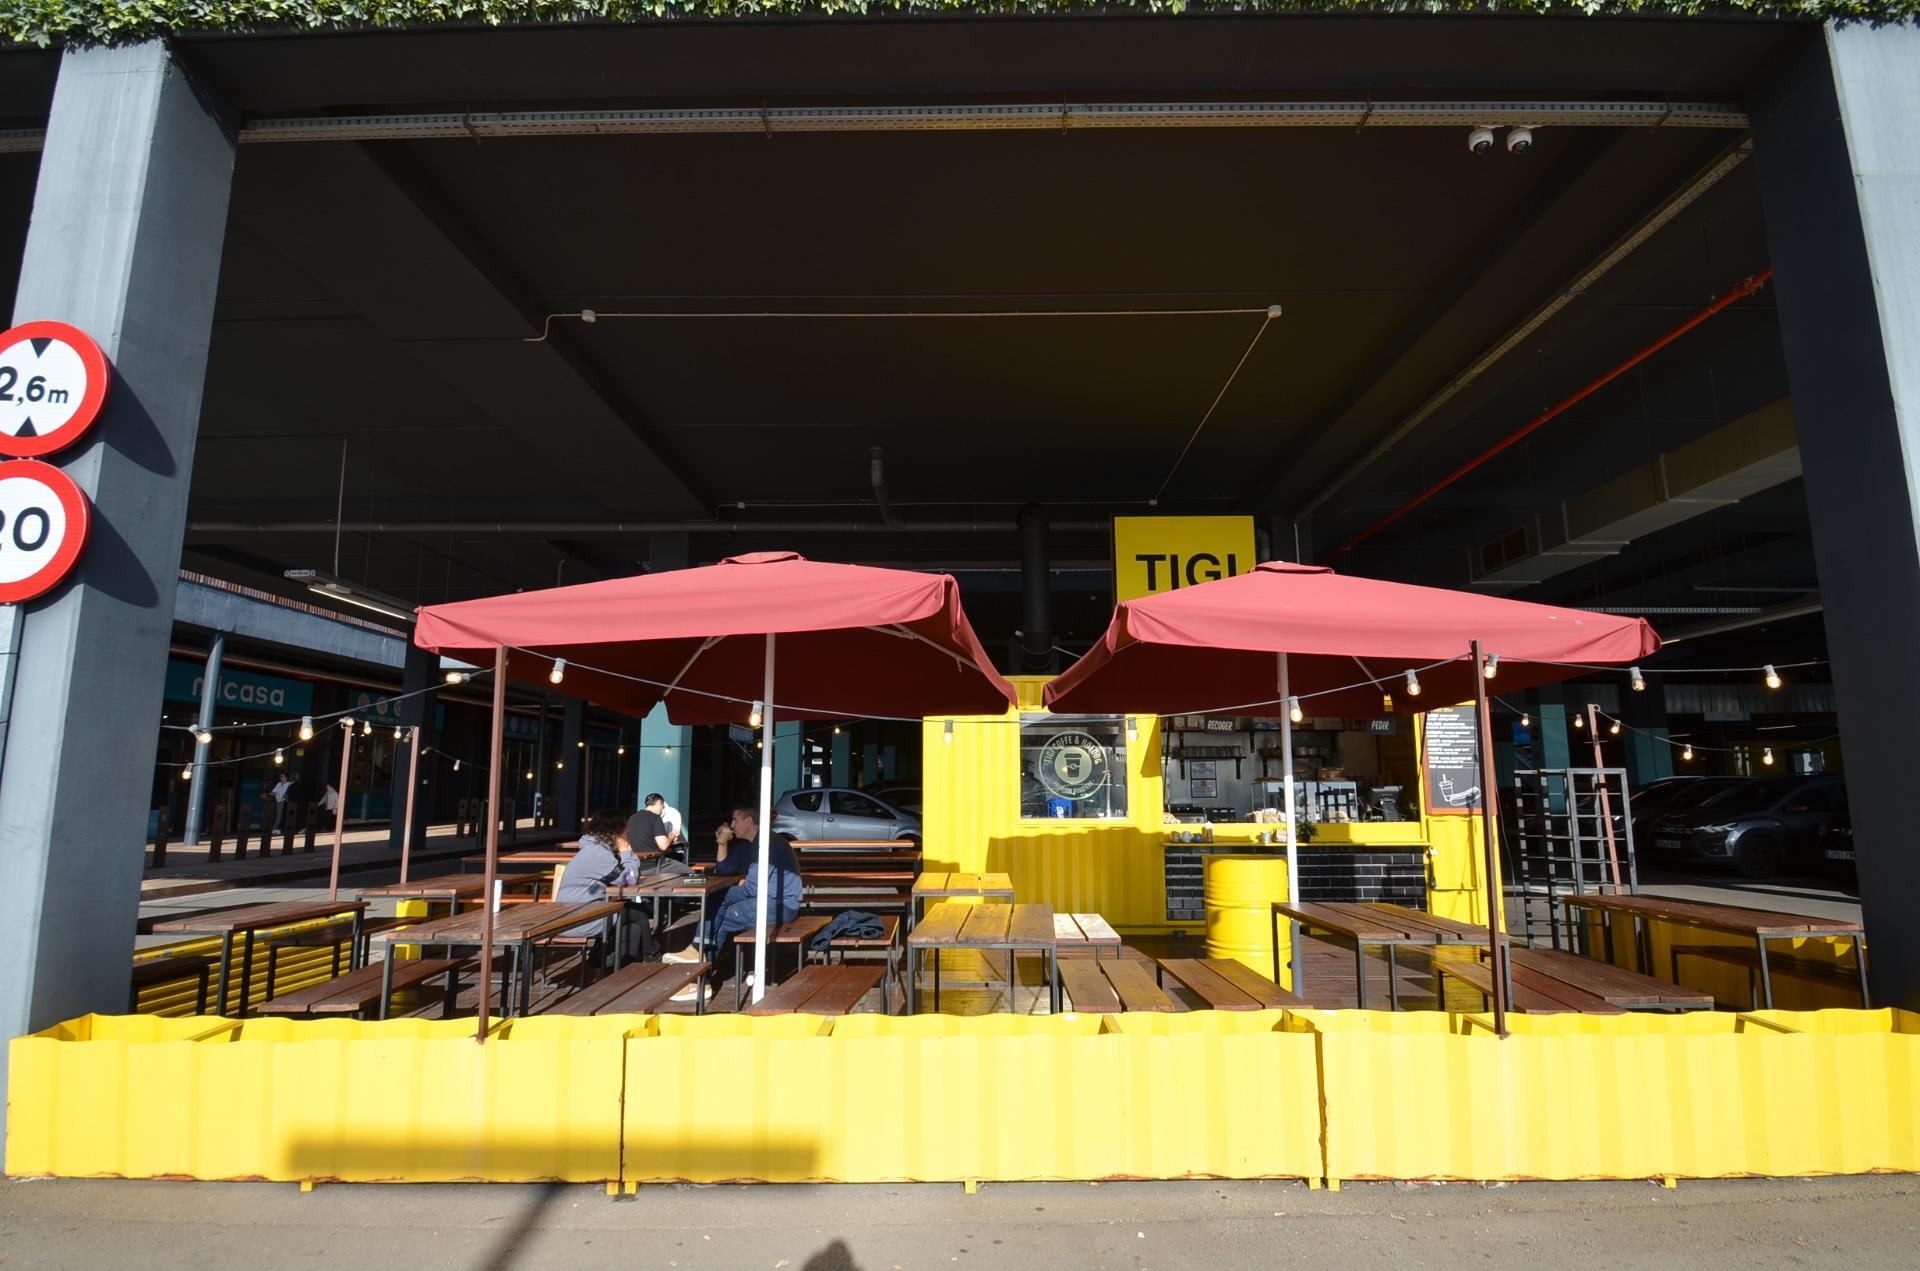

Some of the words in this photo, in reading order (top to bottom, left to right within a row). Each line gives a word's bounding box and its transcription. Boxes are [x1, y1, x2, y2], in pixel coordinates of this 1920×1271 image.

[0, 366, 69, 406] 2,6m
[0, 506, 50, 551] 0
[1207, 719, 1233, 731] RECOGER
[1371, 719, 1390, 731] PEDIR
